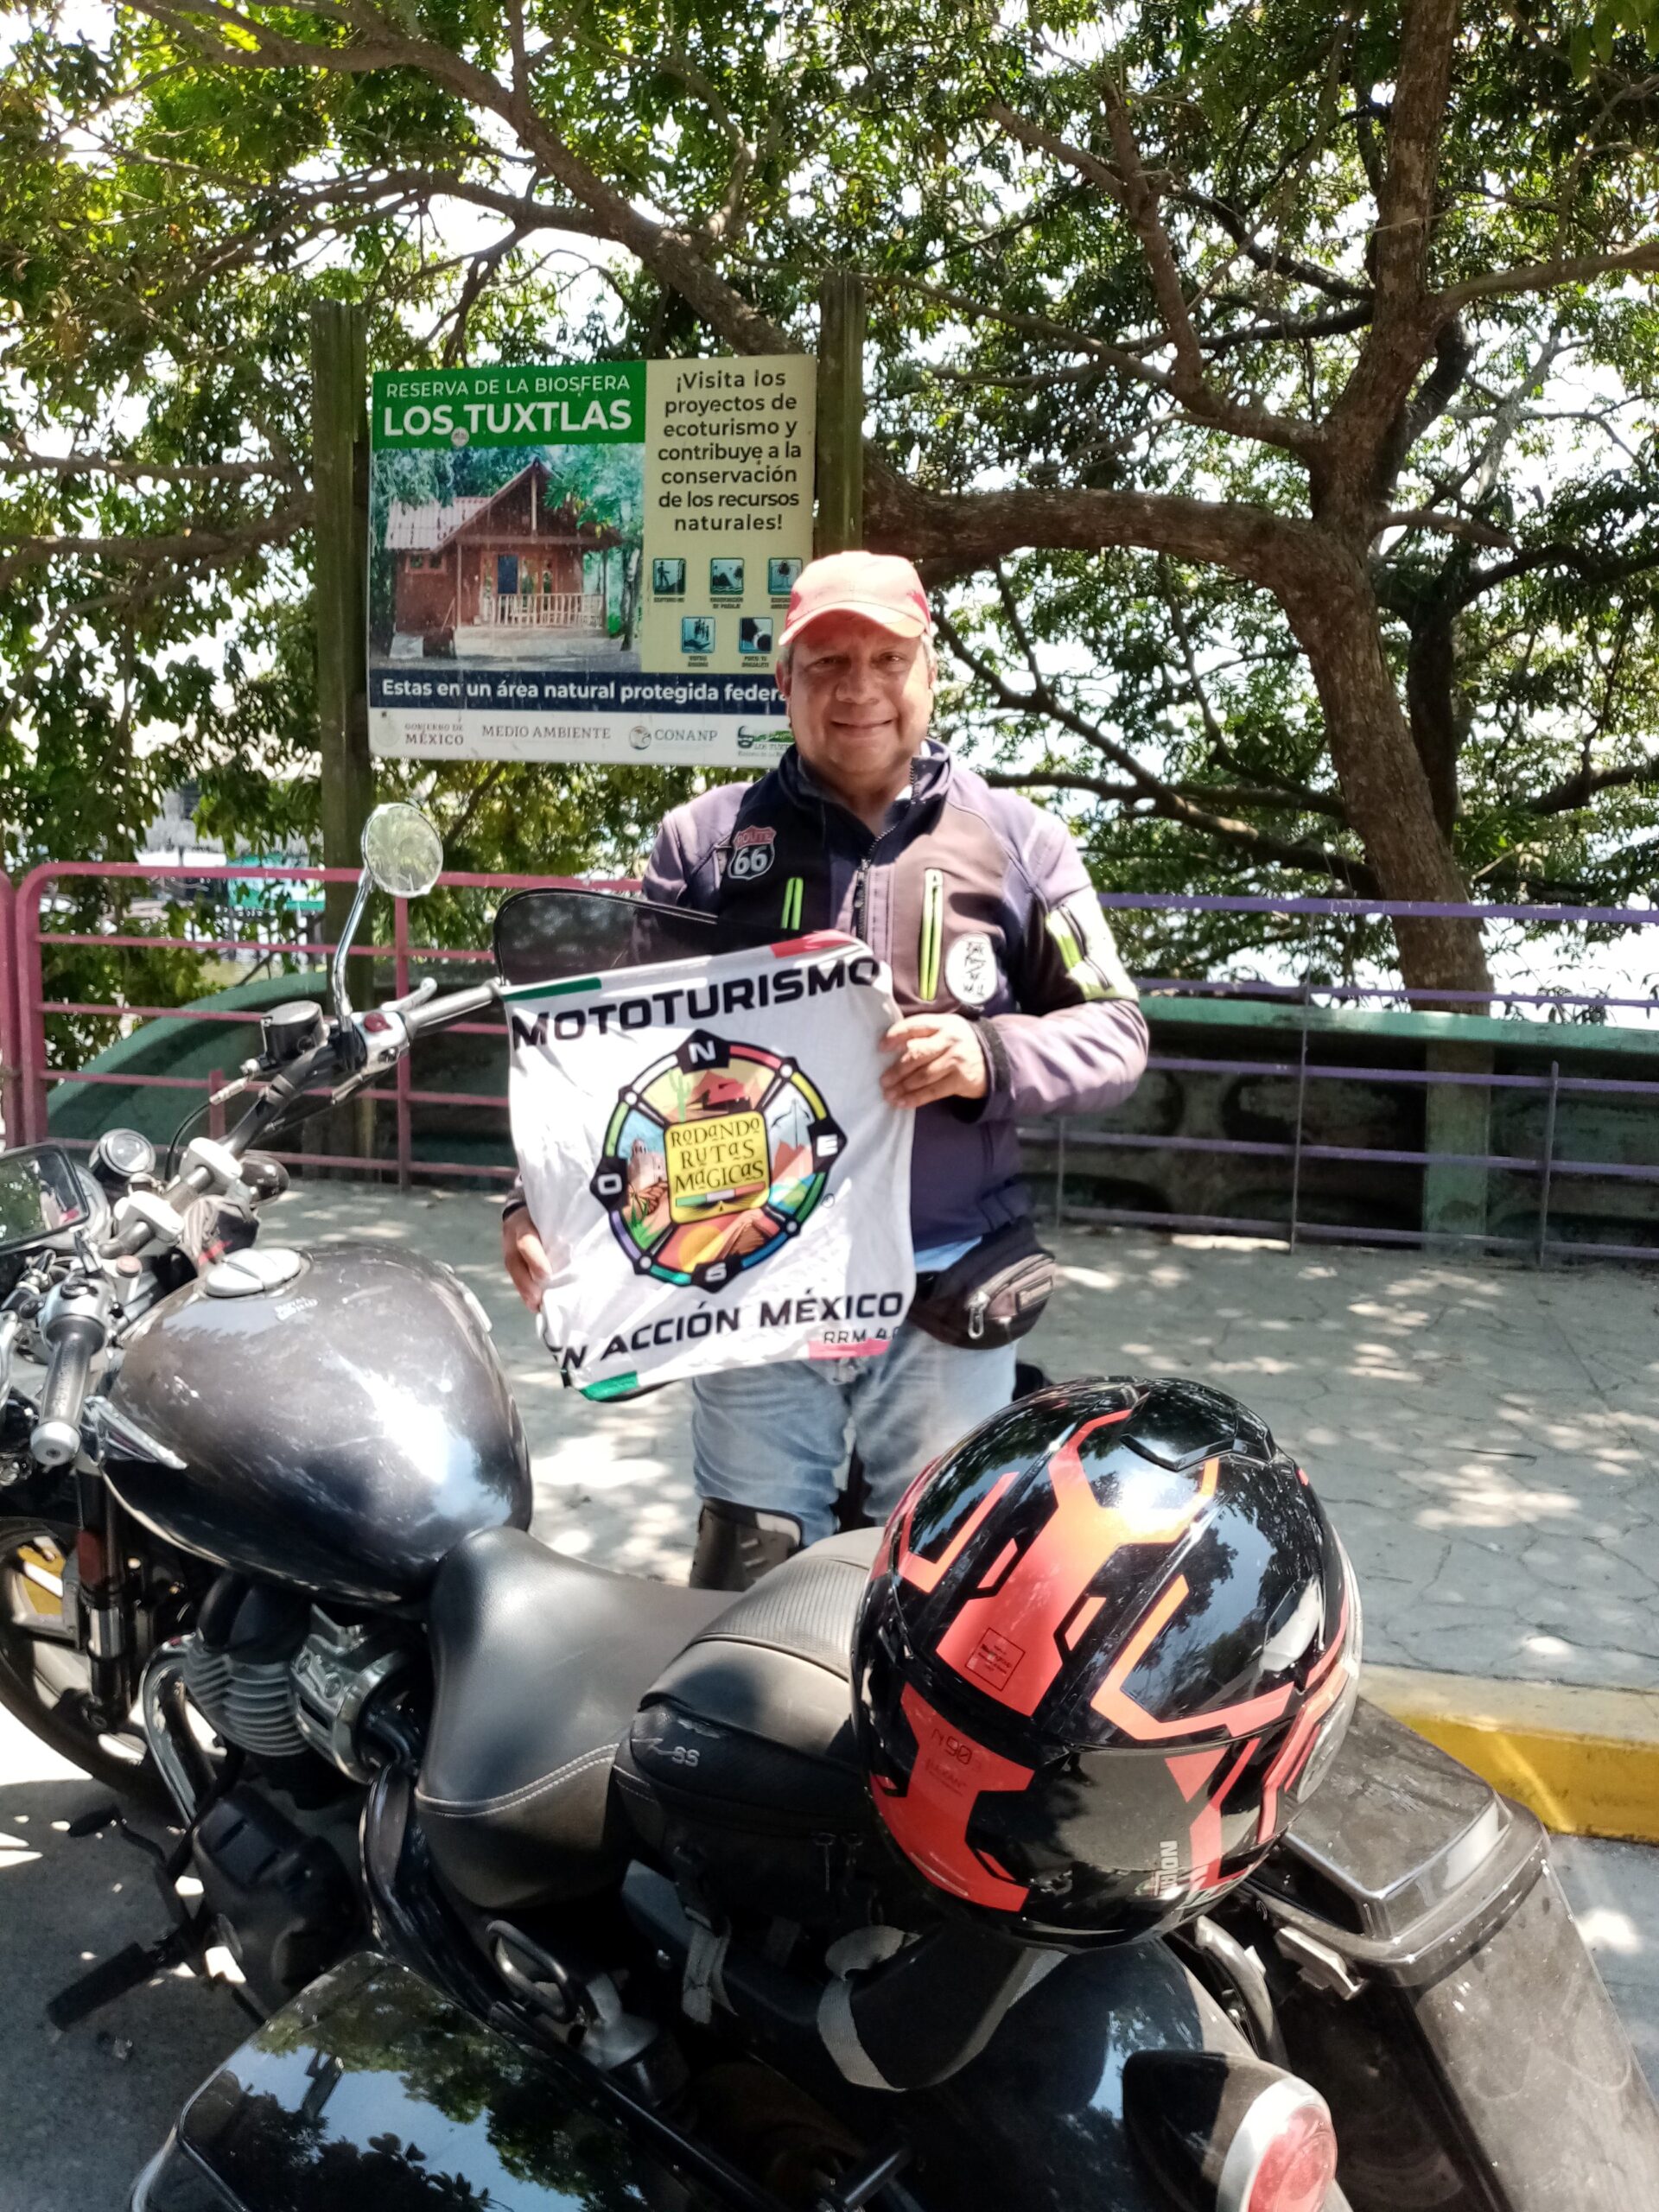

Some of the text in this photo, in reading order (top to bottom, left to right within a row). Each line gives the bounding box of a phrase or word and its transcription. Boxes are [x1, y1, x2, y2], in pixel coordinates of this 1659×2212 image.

[387, 375, 631, 397] RESERVA DE LA BIOSFERA
[677, 369, 786, 392] ¡Visita los
[664, 393, 798, 417] proyectos de
[384, 399, 632, 436] LOS TUXTLAS
[664, 418, 798, 438] ecoturismo y
[658, 442, 802, 463] contribuye a la
[661, 465, 798, 484] conservación
[658, 491, 800, 508] de los recursos
[675, 514, 783, 531] naturales!
[382, 678, 787, 704] Estas en un área natural protegida feder
[405, 725, 718, 746] MÉXICO MEDIO AMBIENTE CONANP
[734, 846, 768, 875] 66
[512, 957, 880, 1049] MOTOTURISMO
[689, 1040, 716, 1064] N
[817, 1133, 838, 1158] E
[600, 1301, 741, 1362] ACCIÓN
[760, 1287, 904, 1327] MÉXICO
